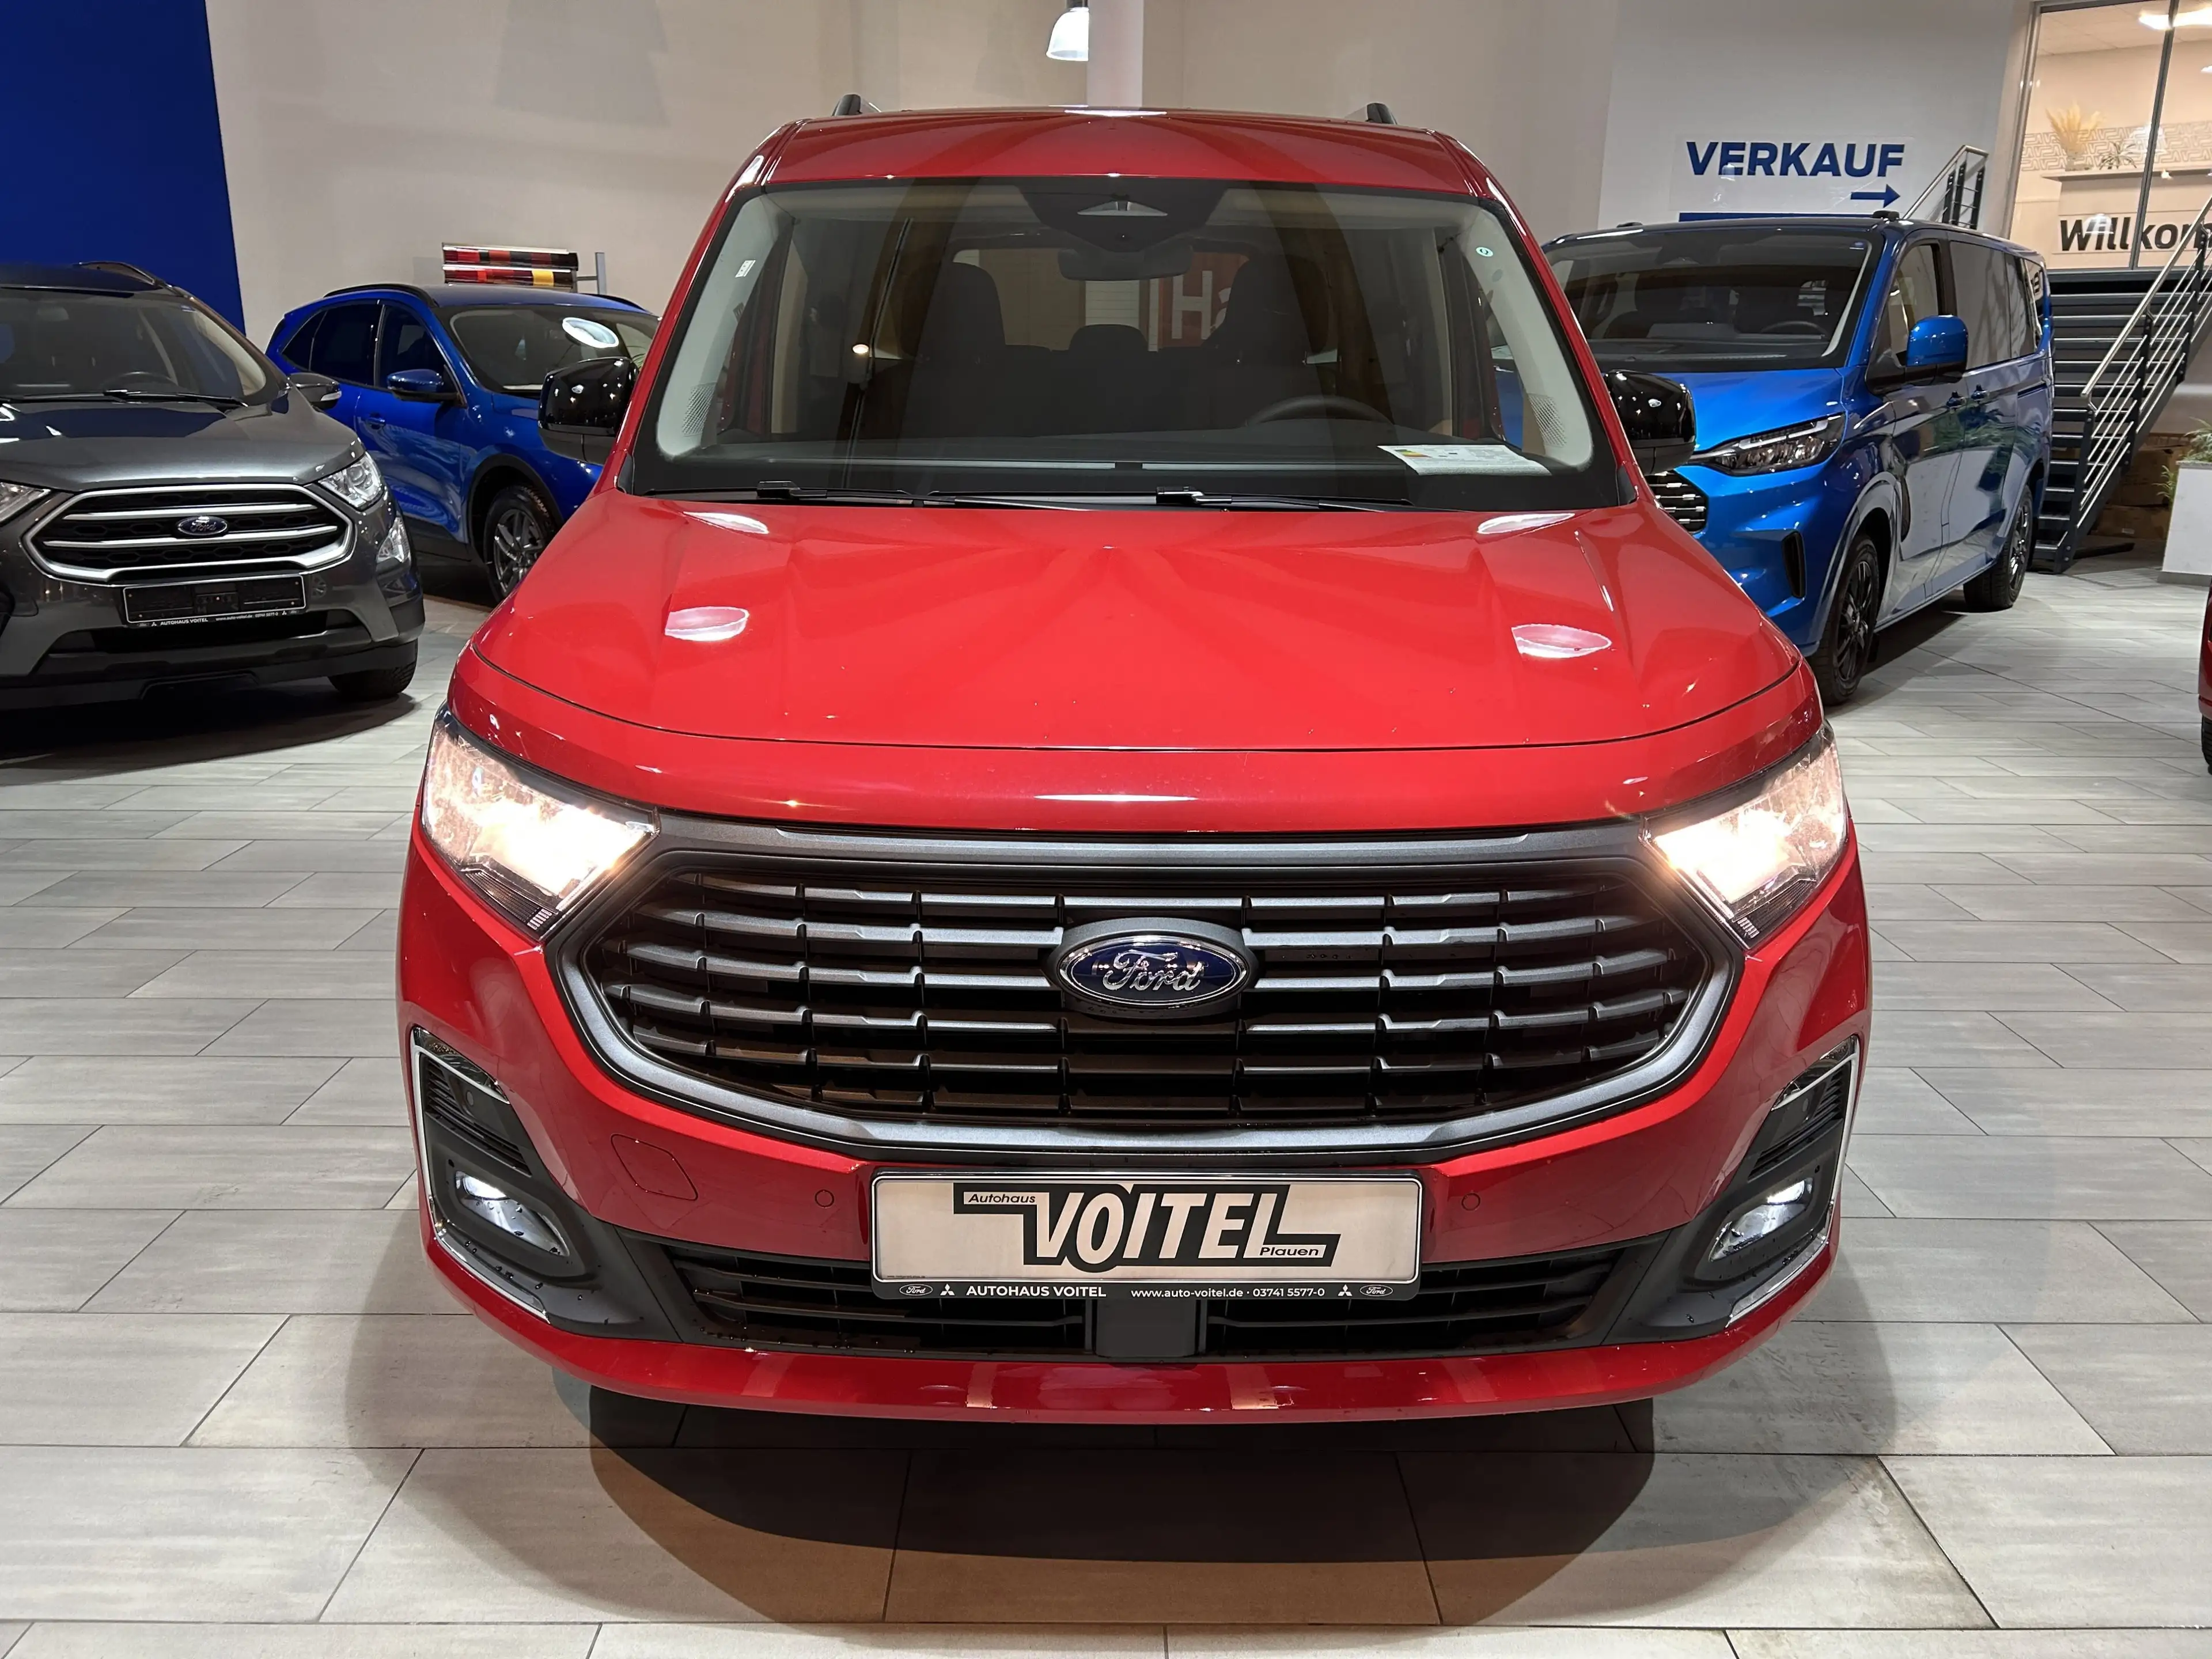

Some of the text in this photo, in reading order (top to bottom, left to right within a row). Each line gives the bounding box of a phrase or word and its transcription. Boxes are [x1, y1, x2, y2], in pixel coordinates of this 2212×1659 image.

[1686, 141, 1905, 177] VERKAUF
[1103, 949, 1204, 991] Ford
[969, 1193, 1036, 1203] Autohaus
[1036, 1192, 1276, 1264] VOITEL
[1259, 1246, 1320, 1257] Plauen
[906, 1286, 926, 1294] Ford
[966, 1285, 1107, 1297] AUTOHAUS VOITEL
[1131, 1287, 1325, 1297] www.auto-voitel.de 03741 5577-0
[1366, 1286, 1387, 1294] Ford
